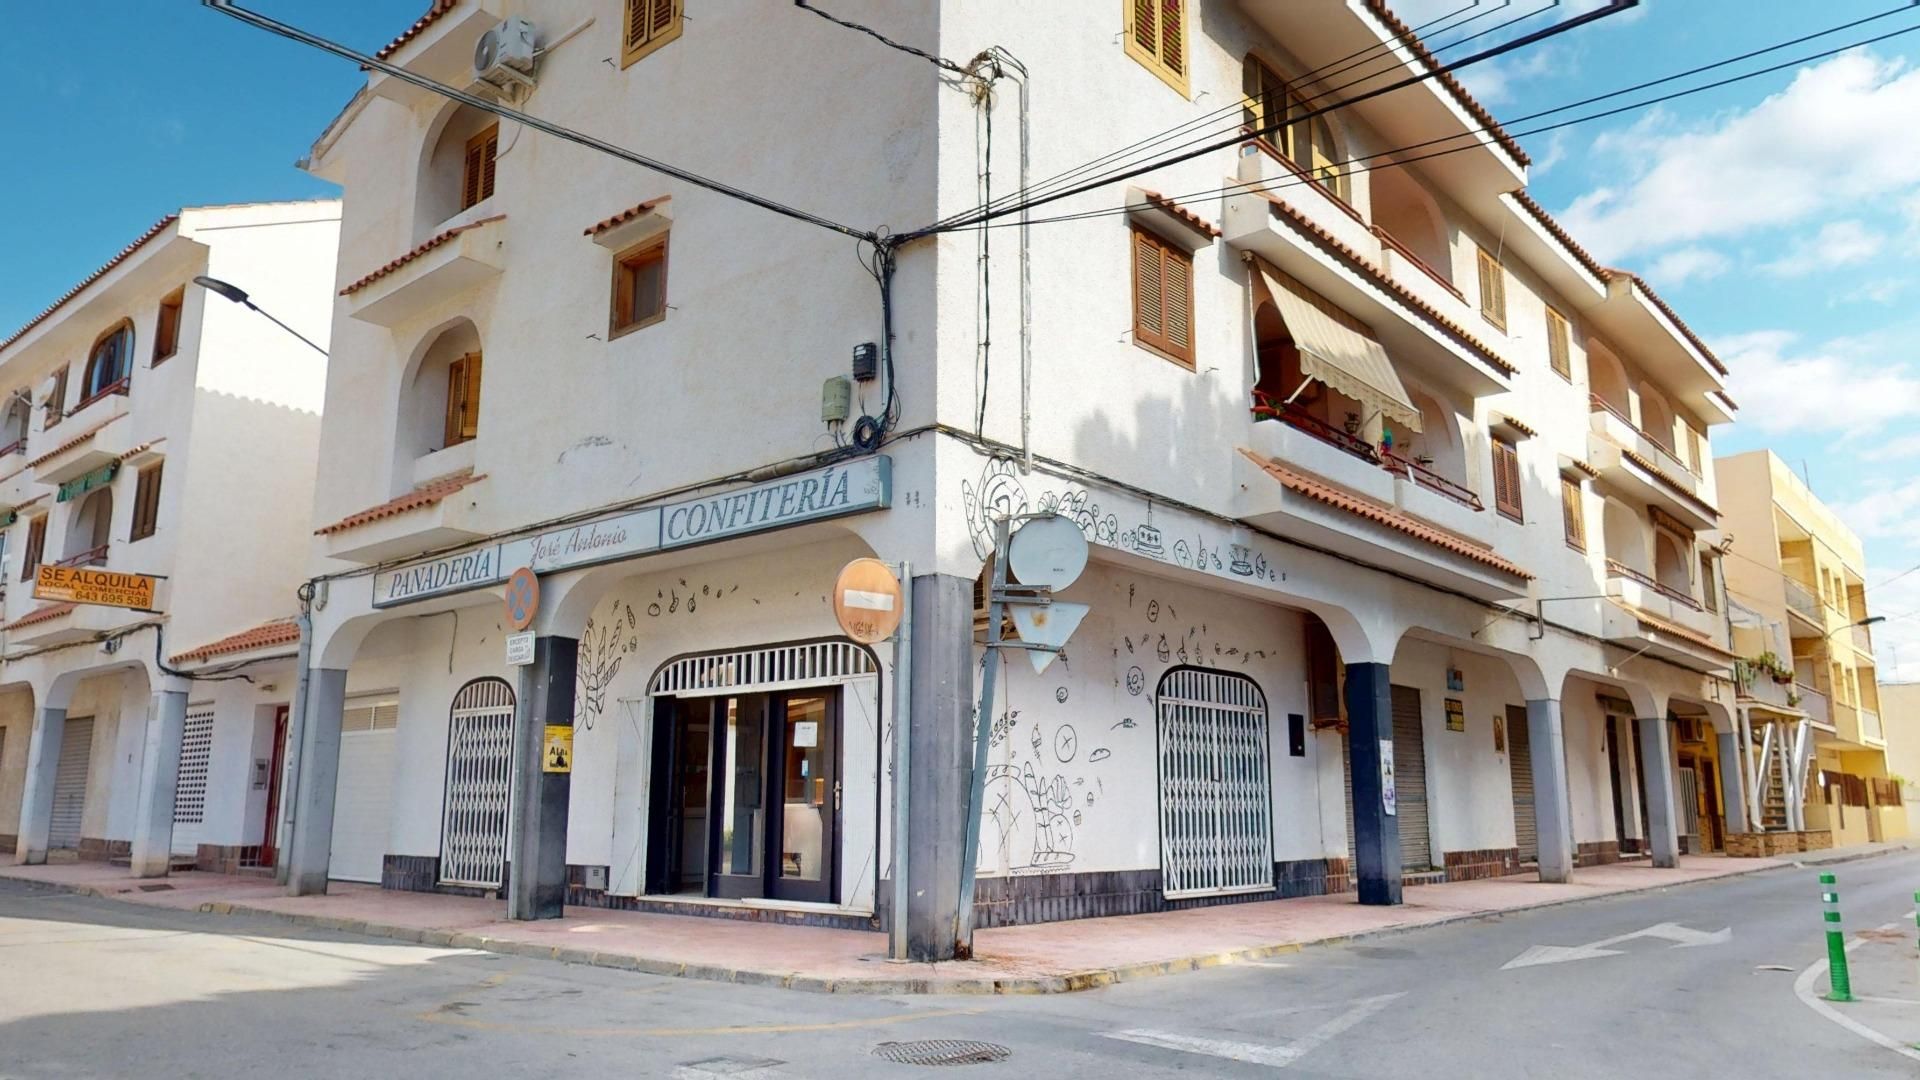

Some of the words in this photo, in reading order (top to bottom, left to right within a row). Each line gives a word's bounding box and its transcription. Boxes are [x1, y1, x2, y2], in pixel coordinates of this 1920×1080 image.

[667, 467, 850, 540] CONFITERÍA
[564, 524, 627, 555] Antonio
[41, 567, 65, 581] SE
[70, 571, 148, 590] ALQUILA
[389, 548, 491, 598] PANADERÍA
[38, 580, 77, 590] LOCAL
[80, 584, 148, 597] COMERCIAL
[75, 590, 98, 601] 643
[101, 593, 123, 604] 695
[127, 596, 148, 607] 538
